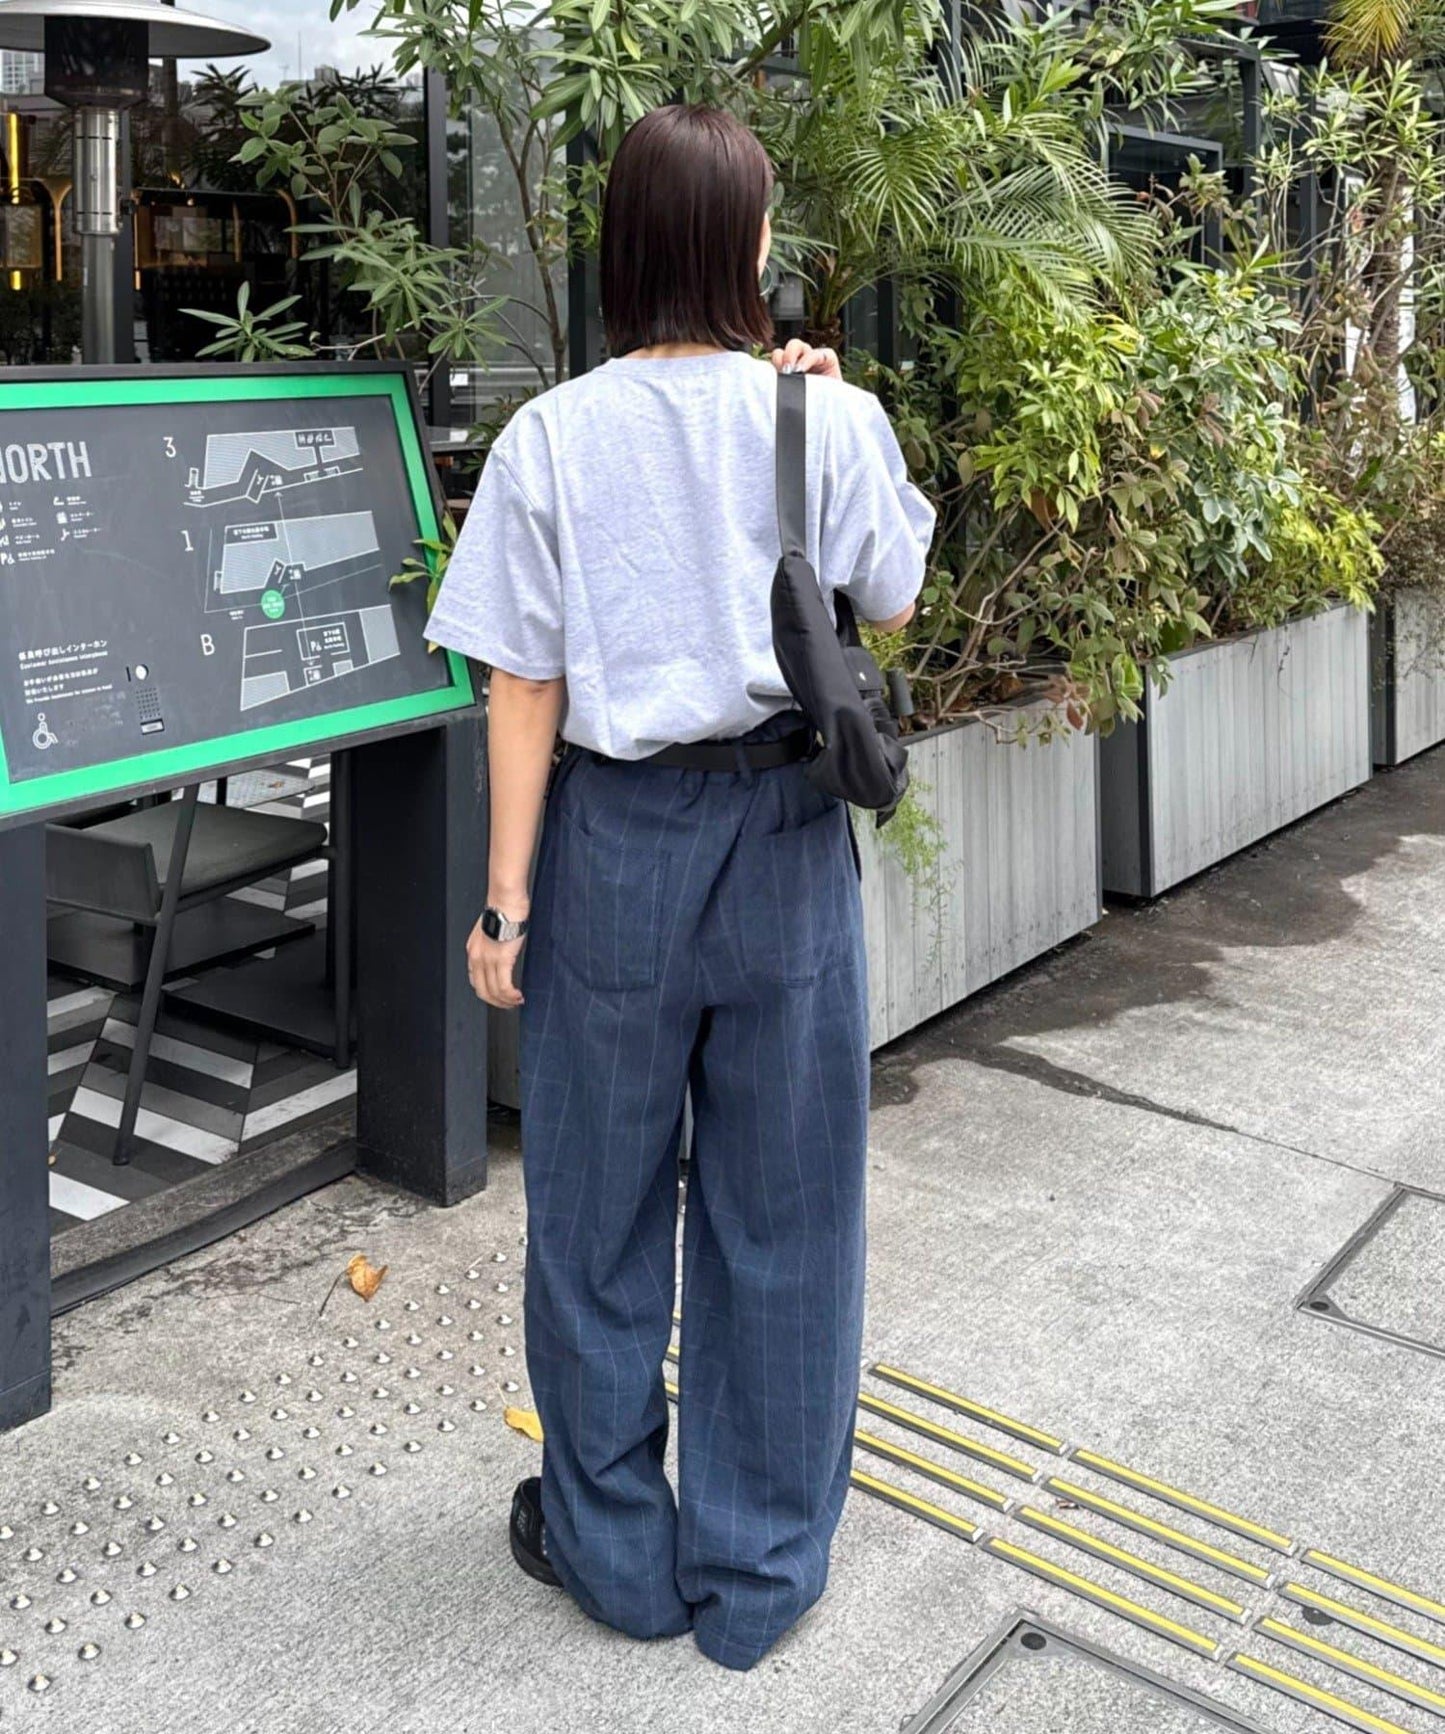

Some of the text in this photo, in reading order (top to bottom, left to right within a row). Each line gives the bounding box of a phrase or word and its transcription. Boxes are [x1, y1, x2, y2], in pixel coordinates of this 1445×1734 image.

[163, 436, 177, 458] 3
[181, 530, 194, 552] 1
[200, 633, 216, 656] B
